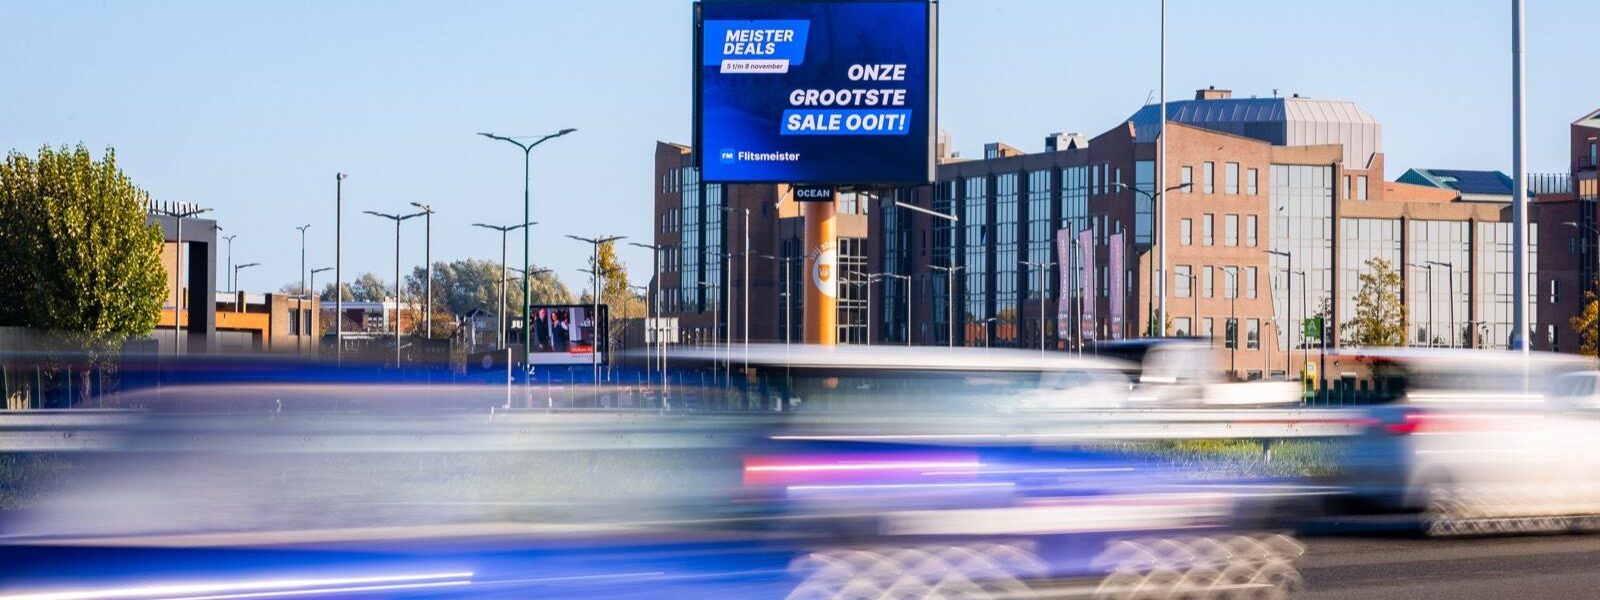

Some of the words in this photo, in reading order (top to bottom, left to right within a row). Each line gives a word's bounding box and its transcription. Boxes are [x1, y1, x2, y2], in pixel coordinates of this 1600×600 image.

[725, 29, 794, 42] MEISTER
[723, 42, 776, 55] DEALS
[847, 64, 907, 81] ONZE
[789, 89, 907, 106] GROOTSTE
[787, 113, 842, 131] SALE
[845, 113, 906, 131] OOIT!
[738, 151, 800, 161] Flitsmeister
[797, 189, 830, 198] OCEAN
